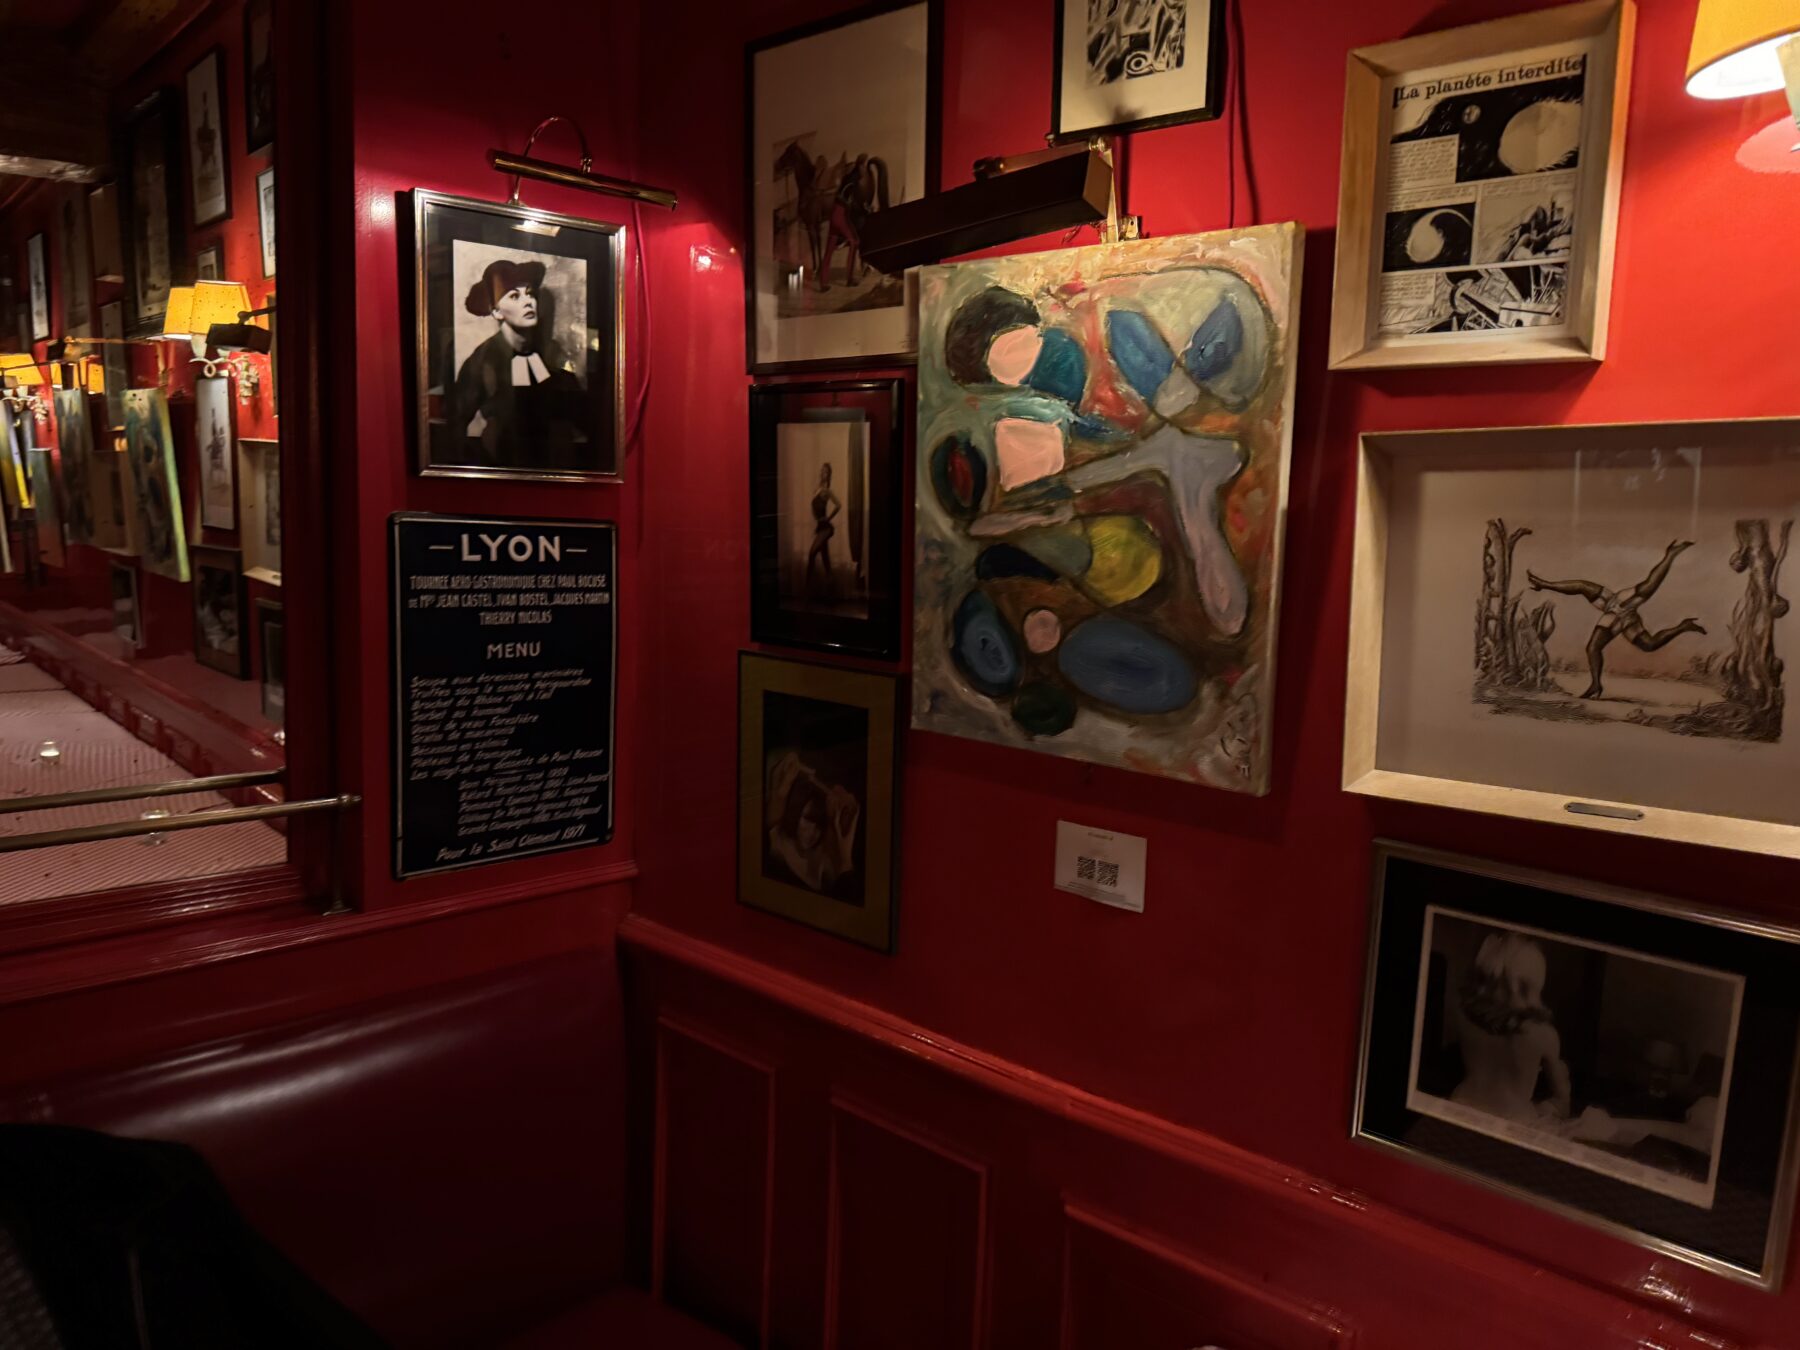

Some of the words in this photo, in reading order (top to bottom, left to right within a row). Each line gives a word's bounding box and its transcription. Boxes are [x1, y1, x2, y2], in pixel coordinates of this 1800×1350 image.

[1398, 85, 1420, 101] La
[1497, 57, 1582, 85] interdite
[461, 533, 561, 562] LYON
[537, 575, 556, 589] CHEZ
[558, 575, 576, 588] PAUL
[578, 574, 607, 588] BOCUSE
[437, 594, 459, 608] JEAN
[479, 611, 516, 625] THIERRY
[518, 610, 552, 625] NICOLAS
[486, 641, 541, 659] MENU
